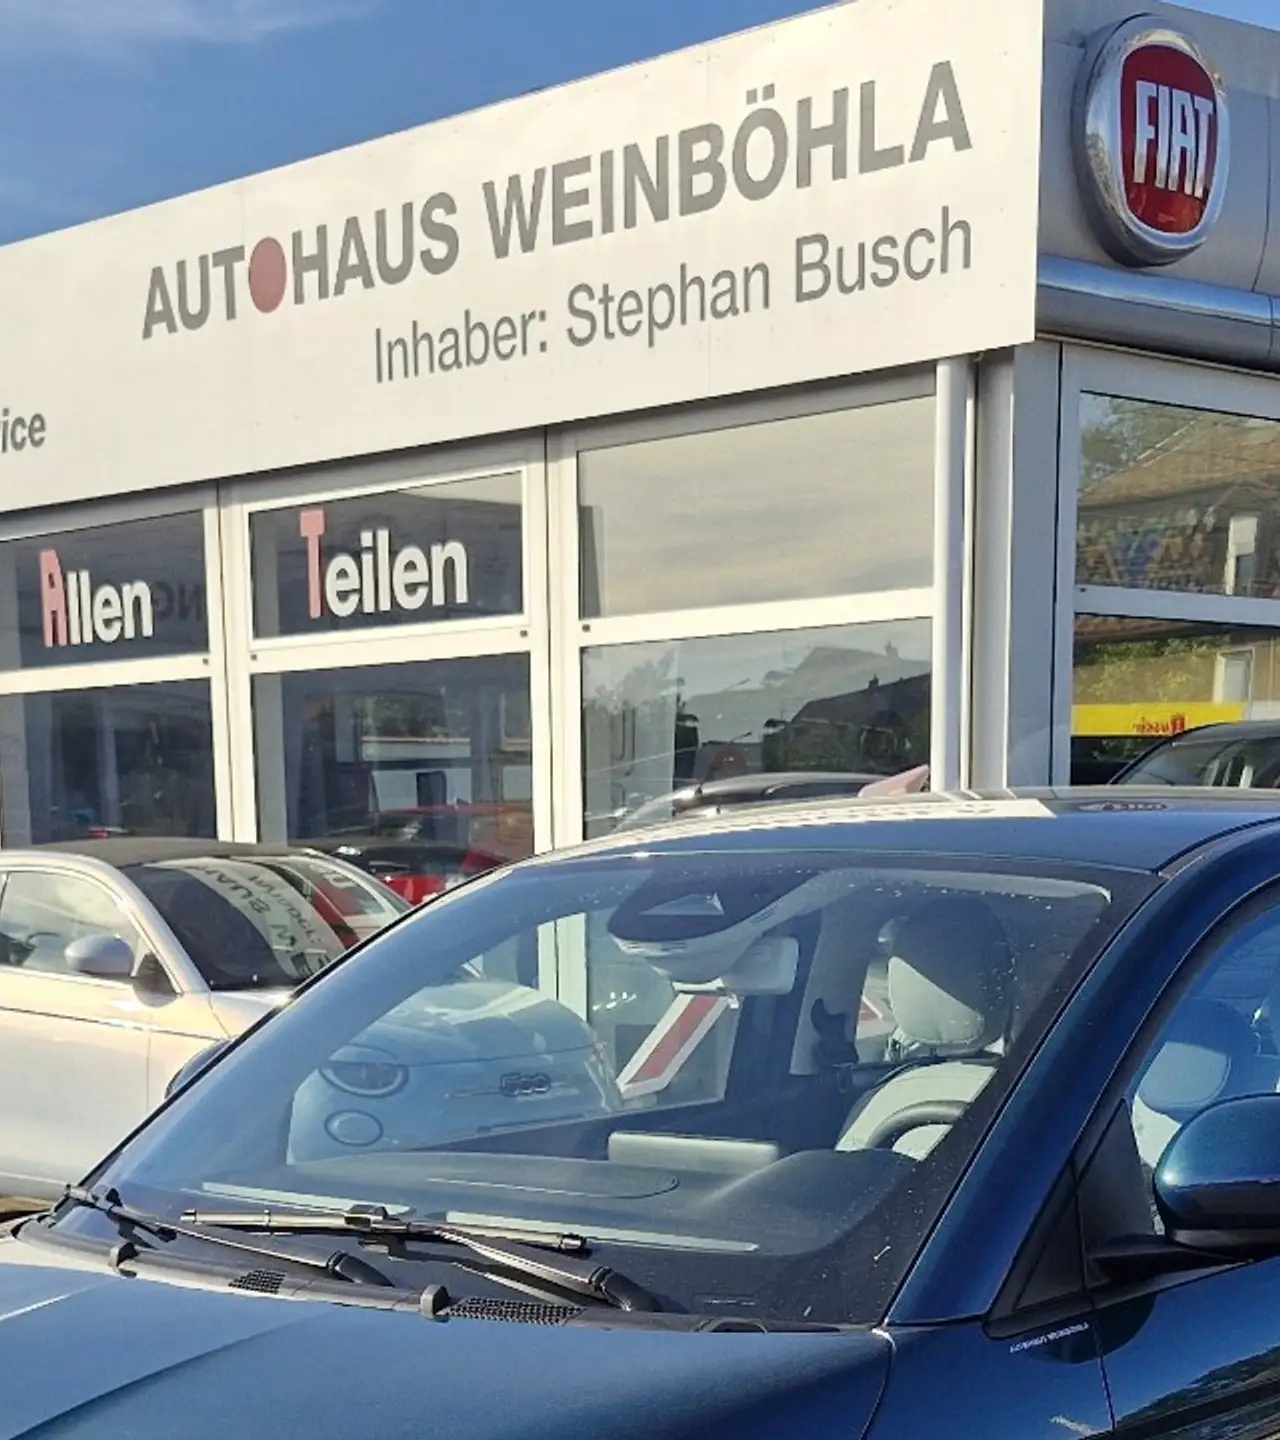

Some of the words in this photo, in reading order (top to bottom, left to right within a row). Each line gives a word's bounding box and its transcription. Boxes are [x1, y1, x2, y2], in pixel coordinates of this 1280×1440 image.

[482, 60, 972, 259] WEINBÖHLA
[1133, 80, 1217, 198] FIAT
[376, 308, 547, 382] Inhaber:
[566, 261, 771, 348] Stephan
[794, 207, 972, 303] Busch
[39, 549, 153, 647] Allen
[299, 510, 468, 619] Teilen
